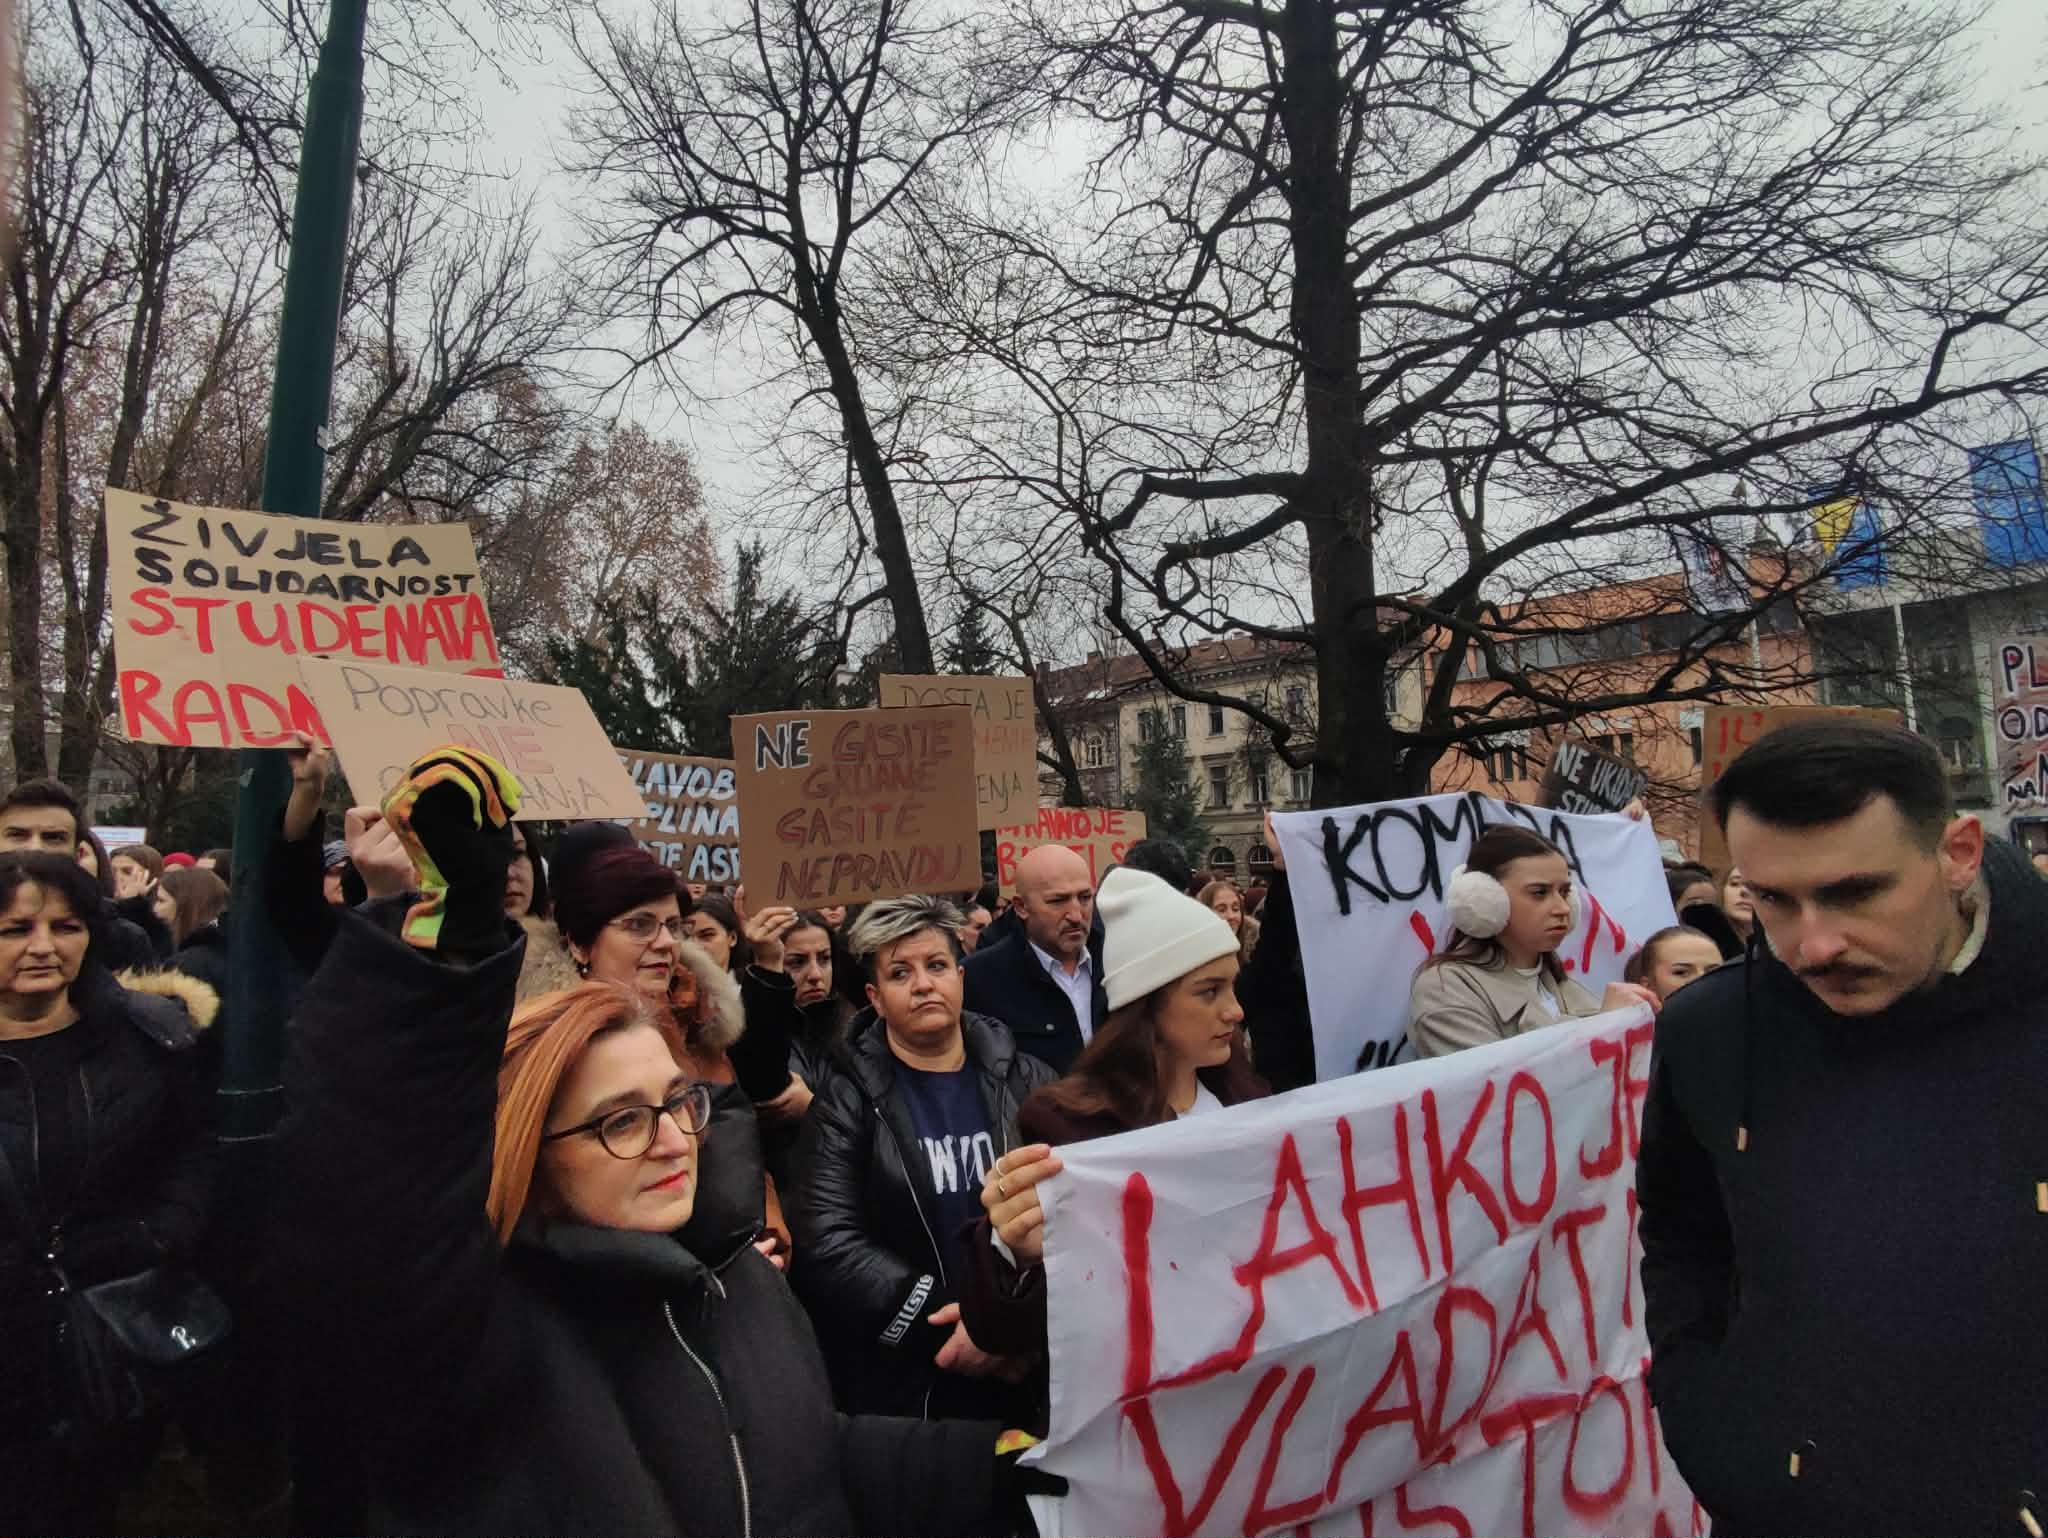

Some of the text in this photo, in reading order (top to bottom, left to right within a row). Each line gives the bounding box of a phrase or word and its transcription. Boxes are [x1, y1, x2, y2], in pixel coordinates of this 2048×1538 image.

[131, 498, 431, 569] ŽIVJELA
[134, 547, 476, 603] SOLIDARNOST
[128, 586, 498, 666] STUDENATA
[341, 666, 564, 727] Popravke
[899, 685, 1025, 720] DOSTA JE
[754, 719, 814, 772] NE
[1553, 740, 1591, 785] NE
[775, 803, 927, 849] GASITE
[776, 844, 964, 901] NEPRAVDU
[1113, 1069, 1557, 1402] LAHKO
